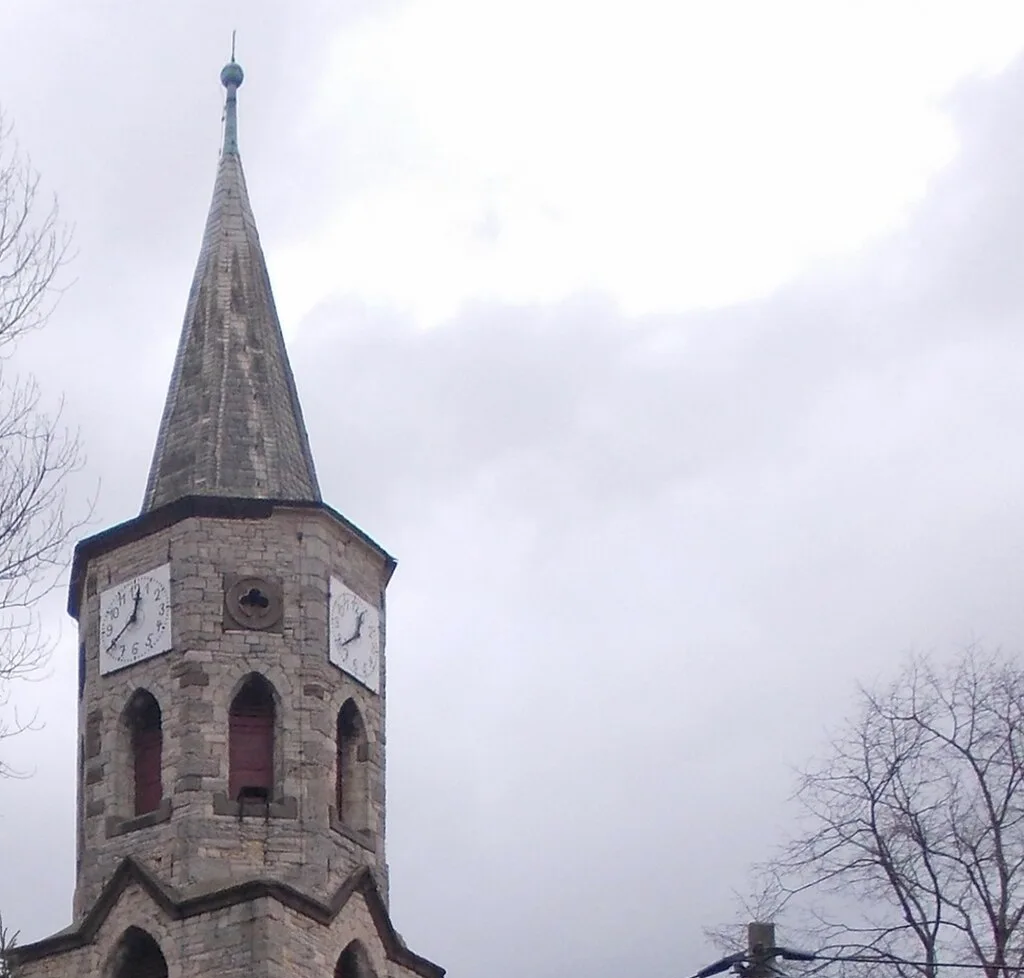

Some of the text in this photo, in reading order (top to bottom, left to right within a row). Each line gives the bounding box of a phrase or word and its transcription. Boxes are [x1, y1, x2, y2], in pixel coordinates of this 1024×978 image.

[158, 602, 165, 616] 3
[106, 624, 113, 637] 9
[132, 642, 139, 655] 6
